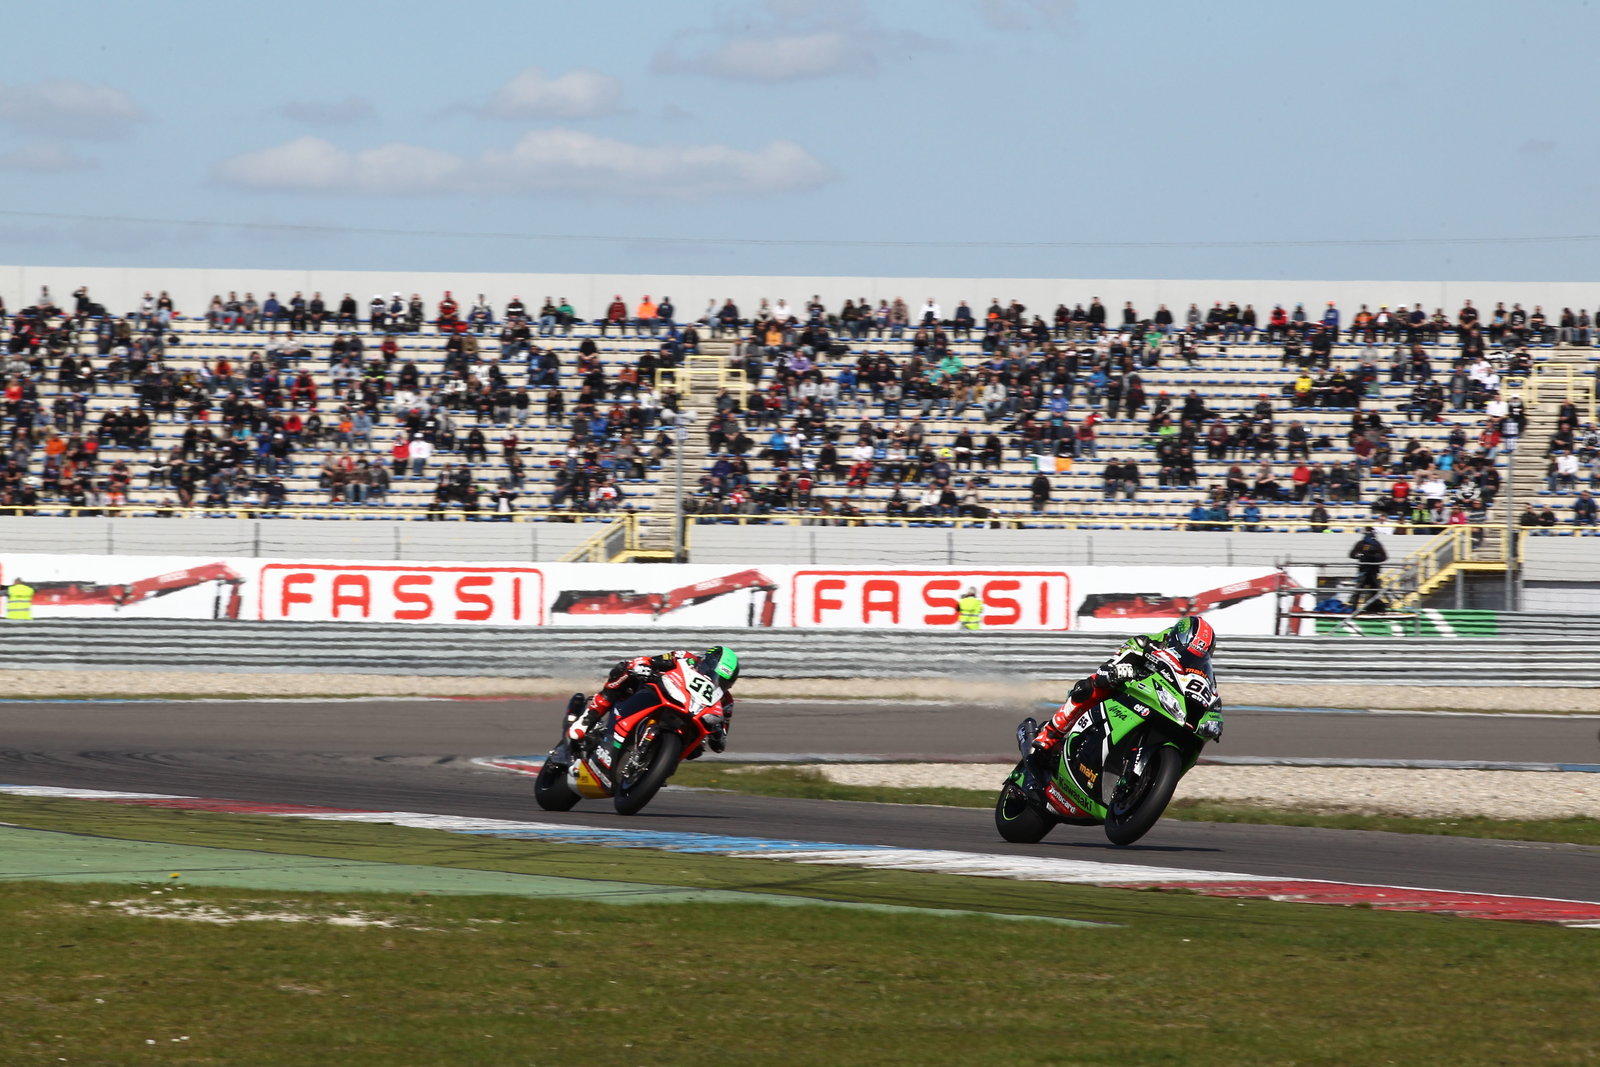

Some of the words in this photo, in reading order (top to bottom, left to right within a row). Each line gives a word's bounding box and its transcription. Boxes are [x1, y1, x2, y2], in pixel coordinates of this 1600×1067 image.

[281, 573, 521, 621] FASSI
[813, 579, 1048, 626] FASSI
[689, 676, 713, 703] 58
[1186, 678, 1212, 704] 66
[1059, 777, 1093, 812] Kawasaki
